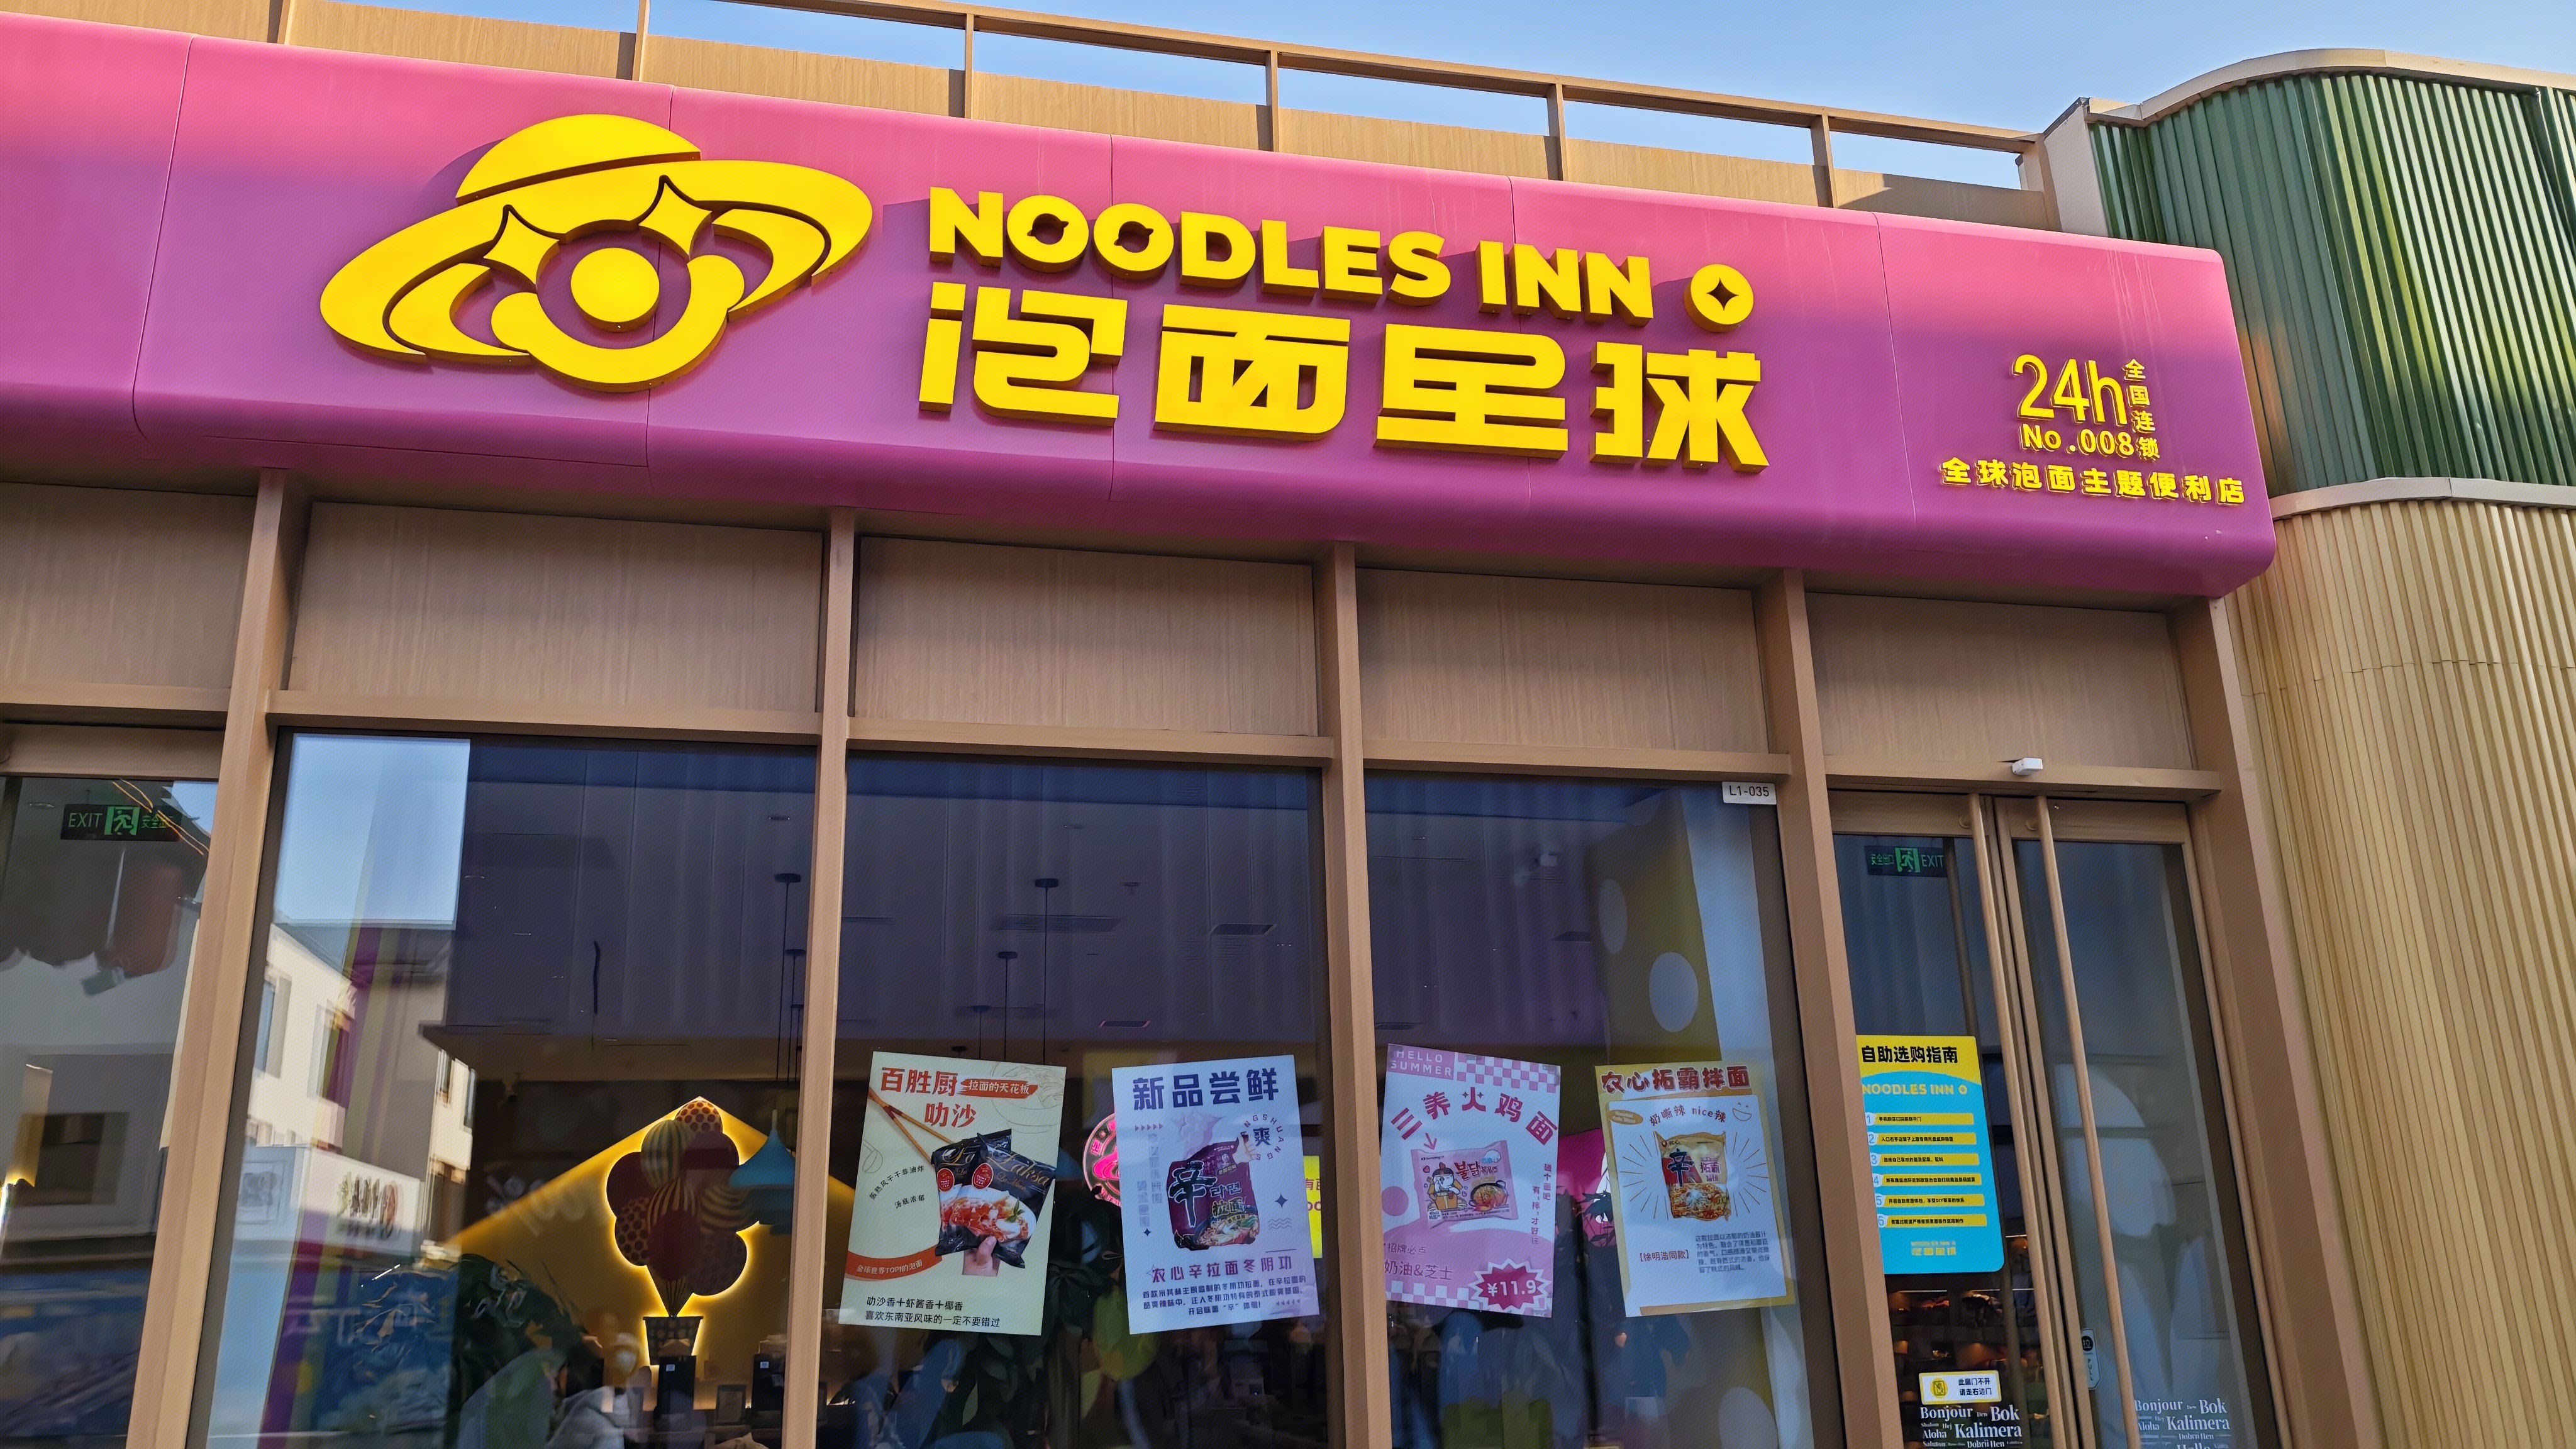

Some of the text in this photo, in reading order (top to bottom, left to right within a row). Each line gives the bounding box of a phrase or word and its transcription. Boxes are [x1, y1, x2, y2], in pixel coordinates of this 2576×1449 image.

[928, 186, 1654, 328] NOODLES INN
[918, 281, 1770, 473] 泡面星球
[2012, 353, 2128, 426] 24h
[2122, 358, 2160, 461] 全国连锁
[1938, 457, 2245, 506] 全球泡面主题便利店
[1729, 785, 1770, 797] L1-035
[68, 813, 103, 828] EXIT
[1921, 854, 1945, 868] EXIT
[1396, 1050, 1443, 1063] HELLO
[1861, 1045, 1958, 1064] 自助选购指南
[1391, 1060, 1452, 1077] SUMMER
[880, 1067, 958, 1096] 百胜厨
[968, 1079, 1030, 1095] 拉面的天花板
[1600, 1064, 1751, 1094] 农心拓霸拌面
[1133, 1067, 1279, 1111] 新品尝鲜
[1863, 1083, 1955, 1096] NOODLES INN
[924, 1102, 977, 1128] 叻沙
[1391, 1086, 1558, 1146] 三养火鸡面
[1253, 1127, 1271, 1146] 爽
[1868, 1134, 1875, 1144] 2
[1667, 1148, 1695, 1188] 辛
[1871, 1155, 1877, 1165] 3
[1874, 1175, 1879, 1185] 4
[1169, 1160, 1218, 1228] 辛
[1876, 1196, 1882, 1206] 5
[1878, 1216, 1884, 1226] 6
[1152, 1255, 1292, 1283] 农心辛拉面冬阴功
[1385, 1258, 1453, 1280] 奶油&芝士
[1487, 1280, 1537, 1297] ¥11.9
[865, 1310, 1001, 1328] 喜欢东南亚风味的一定不要错过
[1959, 1387, 1992, 1396] 请走右边门
[1920, 1405, 1974, 1421] Bonjour
[1990, 1404, 2020, 1421] Bok
[2199, 1397, 2228, 1414] Bok
[1954, 1422, 2023, 1439] Kalimera
[2166, 1414, 2231, 1431] Kalimera
[1923, 1429, 1947, 1439] Aloha
